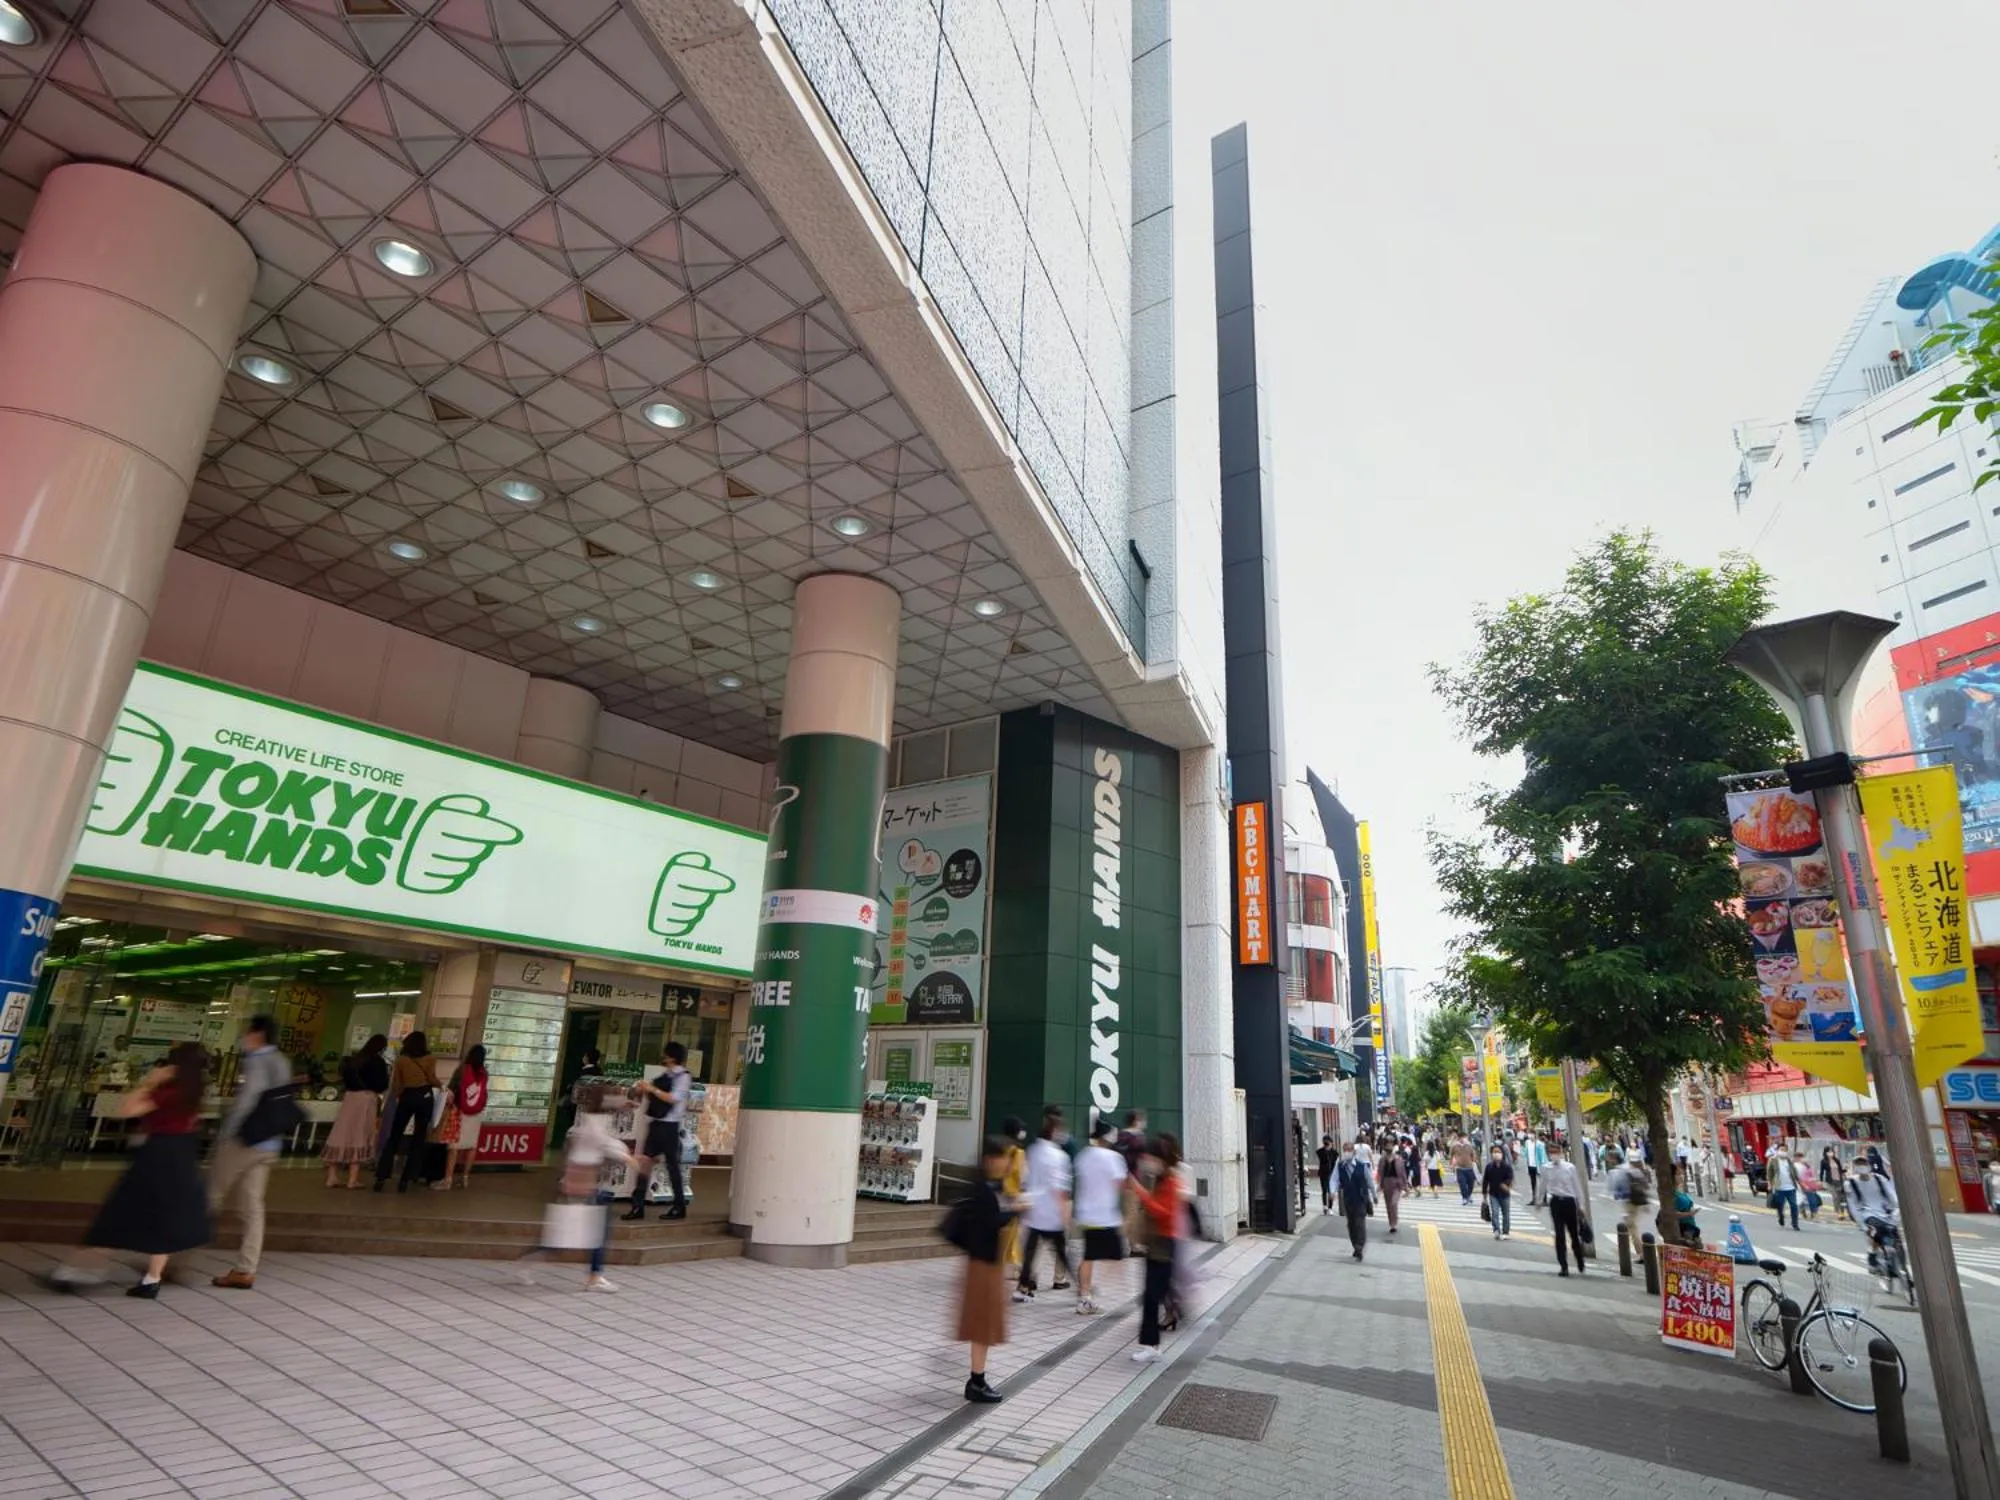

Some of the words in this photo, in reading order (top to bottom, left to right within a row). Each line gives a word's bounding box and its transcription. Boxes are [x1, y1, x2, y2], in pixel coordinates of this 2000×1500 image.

[174, 746, 418, 840] TOKYU
[215, 729, 307, 763] CREATIVE
[310, 752, 346, 773] LIFE
[349, 762, 405, 787] STORE
[141, 797, 393, 886] HANDS
[1092, 747, 1122, 929] HANDS
[664, 938, 694, 950] TOKYU
[695, 943, 723, 955] HANDS
[1906, 863, 1938, 966] まるごとフェア
[1927, 860, 1963, 966] 北海道
[572, 980, 613, 999] EVATOR
[768, 950, 800, 960] HANDS
[1679, 1274, 1732, 1306] 焼肉
